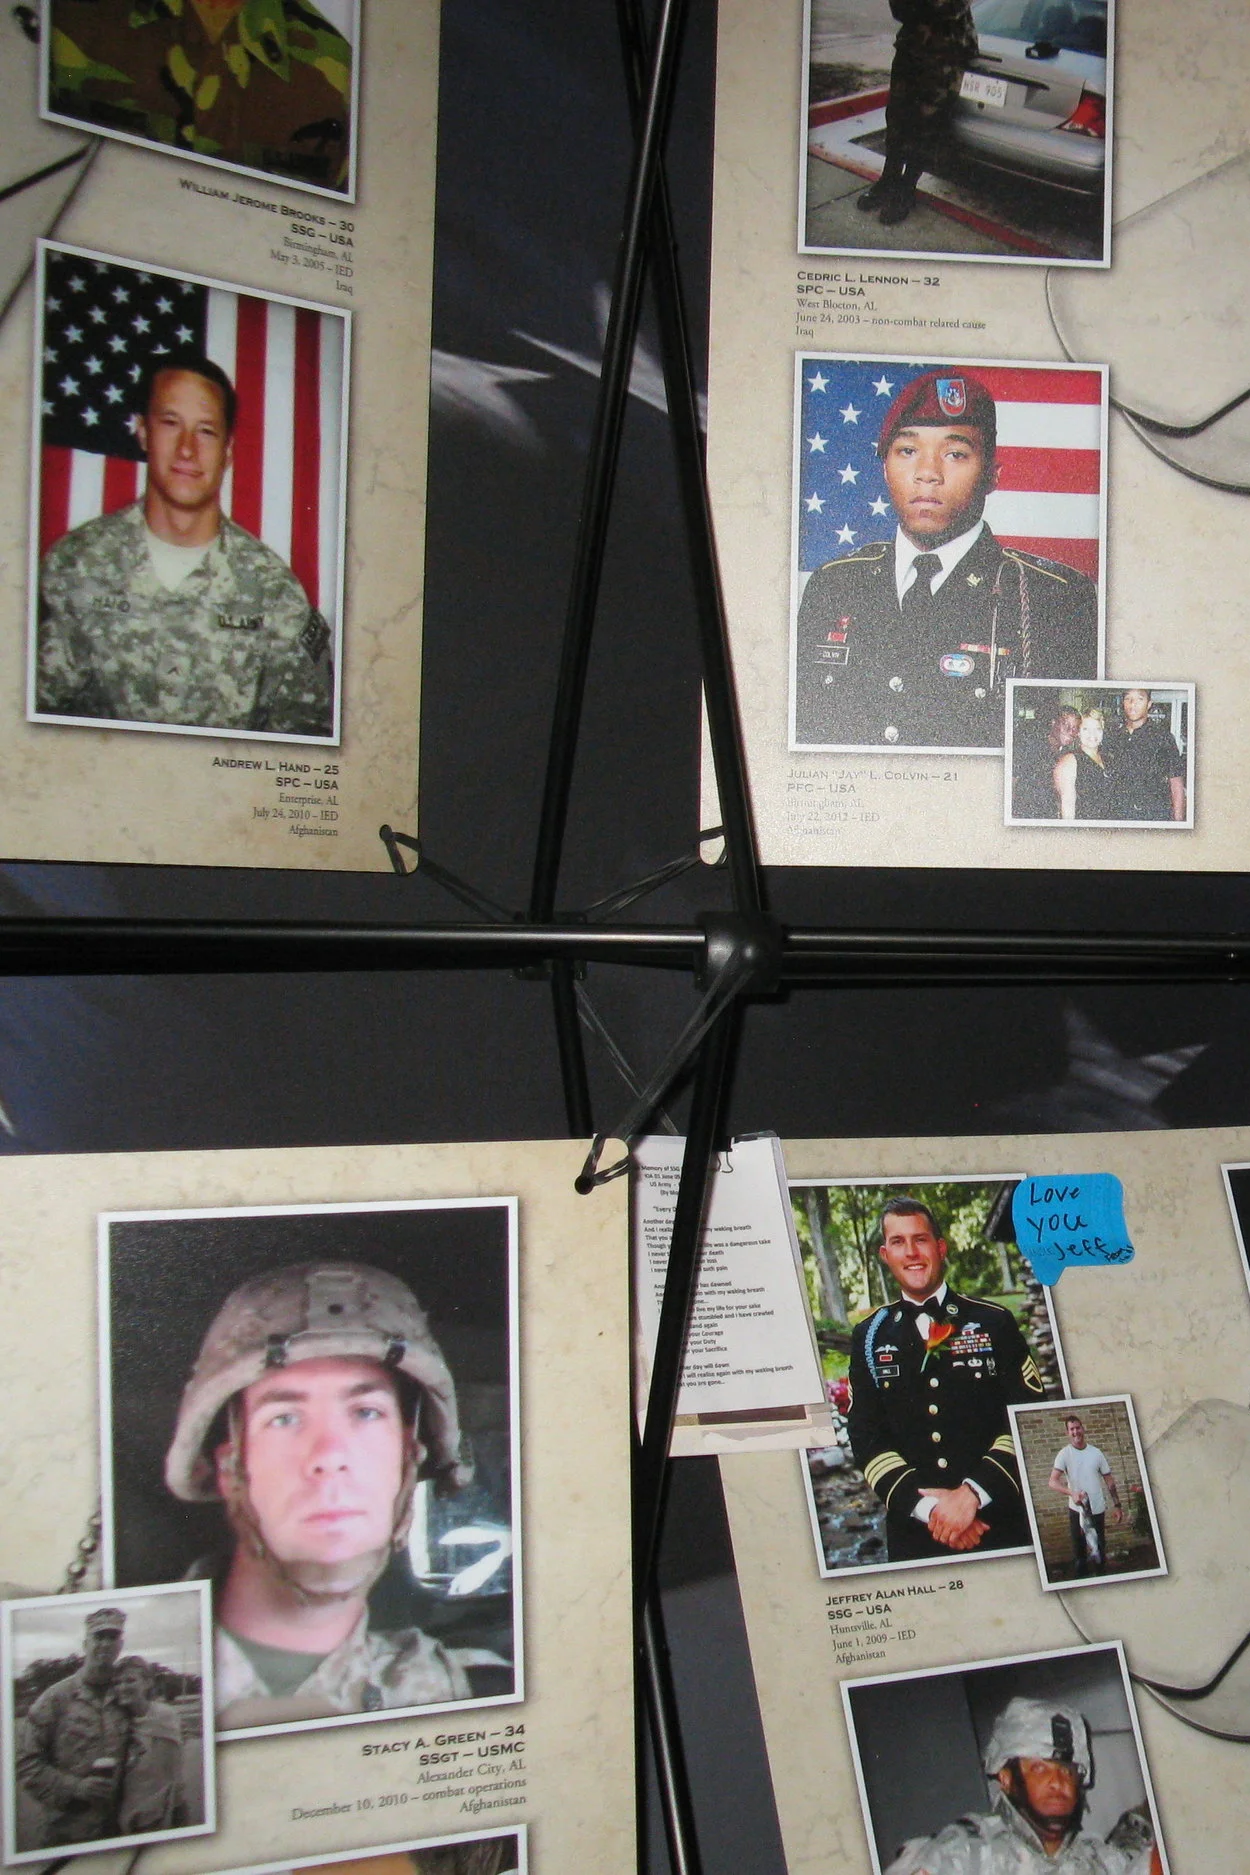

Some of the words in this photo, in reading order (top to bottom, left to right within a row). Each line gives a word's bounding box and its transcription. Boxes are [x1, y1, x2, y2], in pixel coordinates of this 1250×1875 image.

[280, 205, 325, 226] BROOKS
[339, 220, 354, 233] 30
[291, 223, 316, 238] SSG
[329, 232, 354, 248] USA
[797, 271, 841, 282] CEDRIC
[844, 273, 856, 283] L.
[859, 273, 909, 285] LENNON
[923, 276, 940, 287] 32
[797, 284, 823, 295] SPC
[839, 286, 866, 297] USA
[796, 298, 820, 309] West
[795, 312, 817, 324] June
[837, 314, 861, 325] 2003
[930, 318, 960, 329] related
[962, 321, 987, 330] cause
[795, 326, 814, 338] Iraq
[212, 756, 262, 770] ANDREW
[279, 762, 311, 773] HAND
[324, 765, 340, 775] 25
[275, 776, 301, 788] SPC
[314, 779, 339, 790] USA
[943, 771, 959, 782] 21
[829, 783, 856, 793] USA
[252, 806, 270, 820] July
[288, 809, 310, 820] 2010
[320, 810, 339, 821] IED
[289, 824, 338, 838] Afghanistan
[1030, 1182, 1081, 1206] Love
[826, 1592, 873, 1607] JEFFREY
[875, 1589, 905, 1600] ALAN
[907, 1585, 936, 1596] HALL
[948, 1580, 964, 1591] 28
[827, 1608, 853, 1620] SSG
[866, 1604, 892, 1615] USA
[830, 1620, 877, 1635] Huntsville,
[879, 1617, 893, 1628] AL
[832, 1638, 853, 1651] June
[866, 1633, 888, 1646] 2009
[897, 1629, 916, 1641] IED
[835, 1650, 886, 1665] Afghanistan
[361, 1741, 411, 1756] STACY
[414, 1737, 430, 1749] A.
[434, 1731, 487, 1747] GREEN
[504, 1724, 525, 1737] 34
[477, 1741, 526, 1758] USMC
[416, 1767, 474, 1785] Alexander
[476, 1762, 506, 1778] City,
[509, 1758, 526, 1771] AL
[291, 1803, 352, 1821] December
[378, 1792, 408, 1808] 2010
[422, 1787, 465, 1801] combat
[467, 1778, 527, 1797] operations
[459, 1795, 527, 1815] Afghanistan
